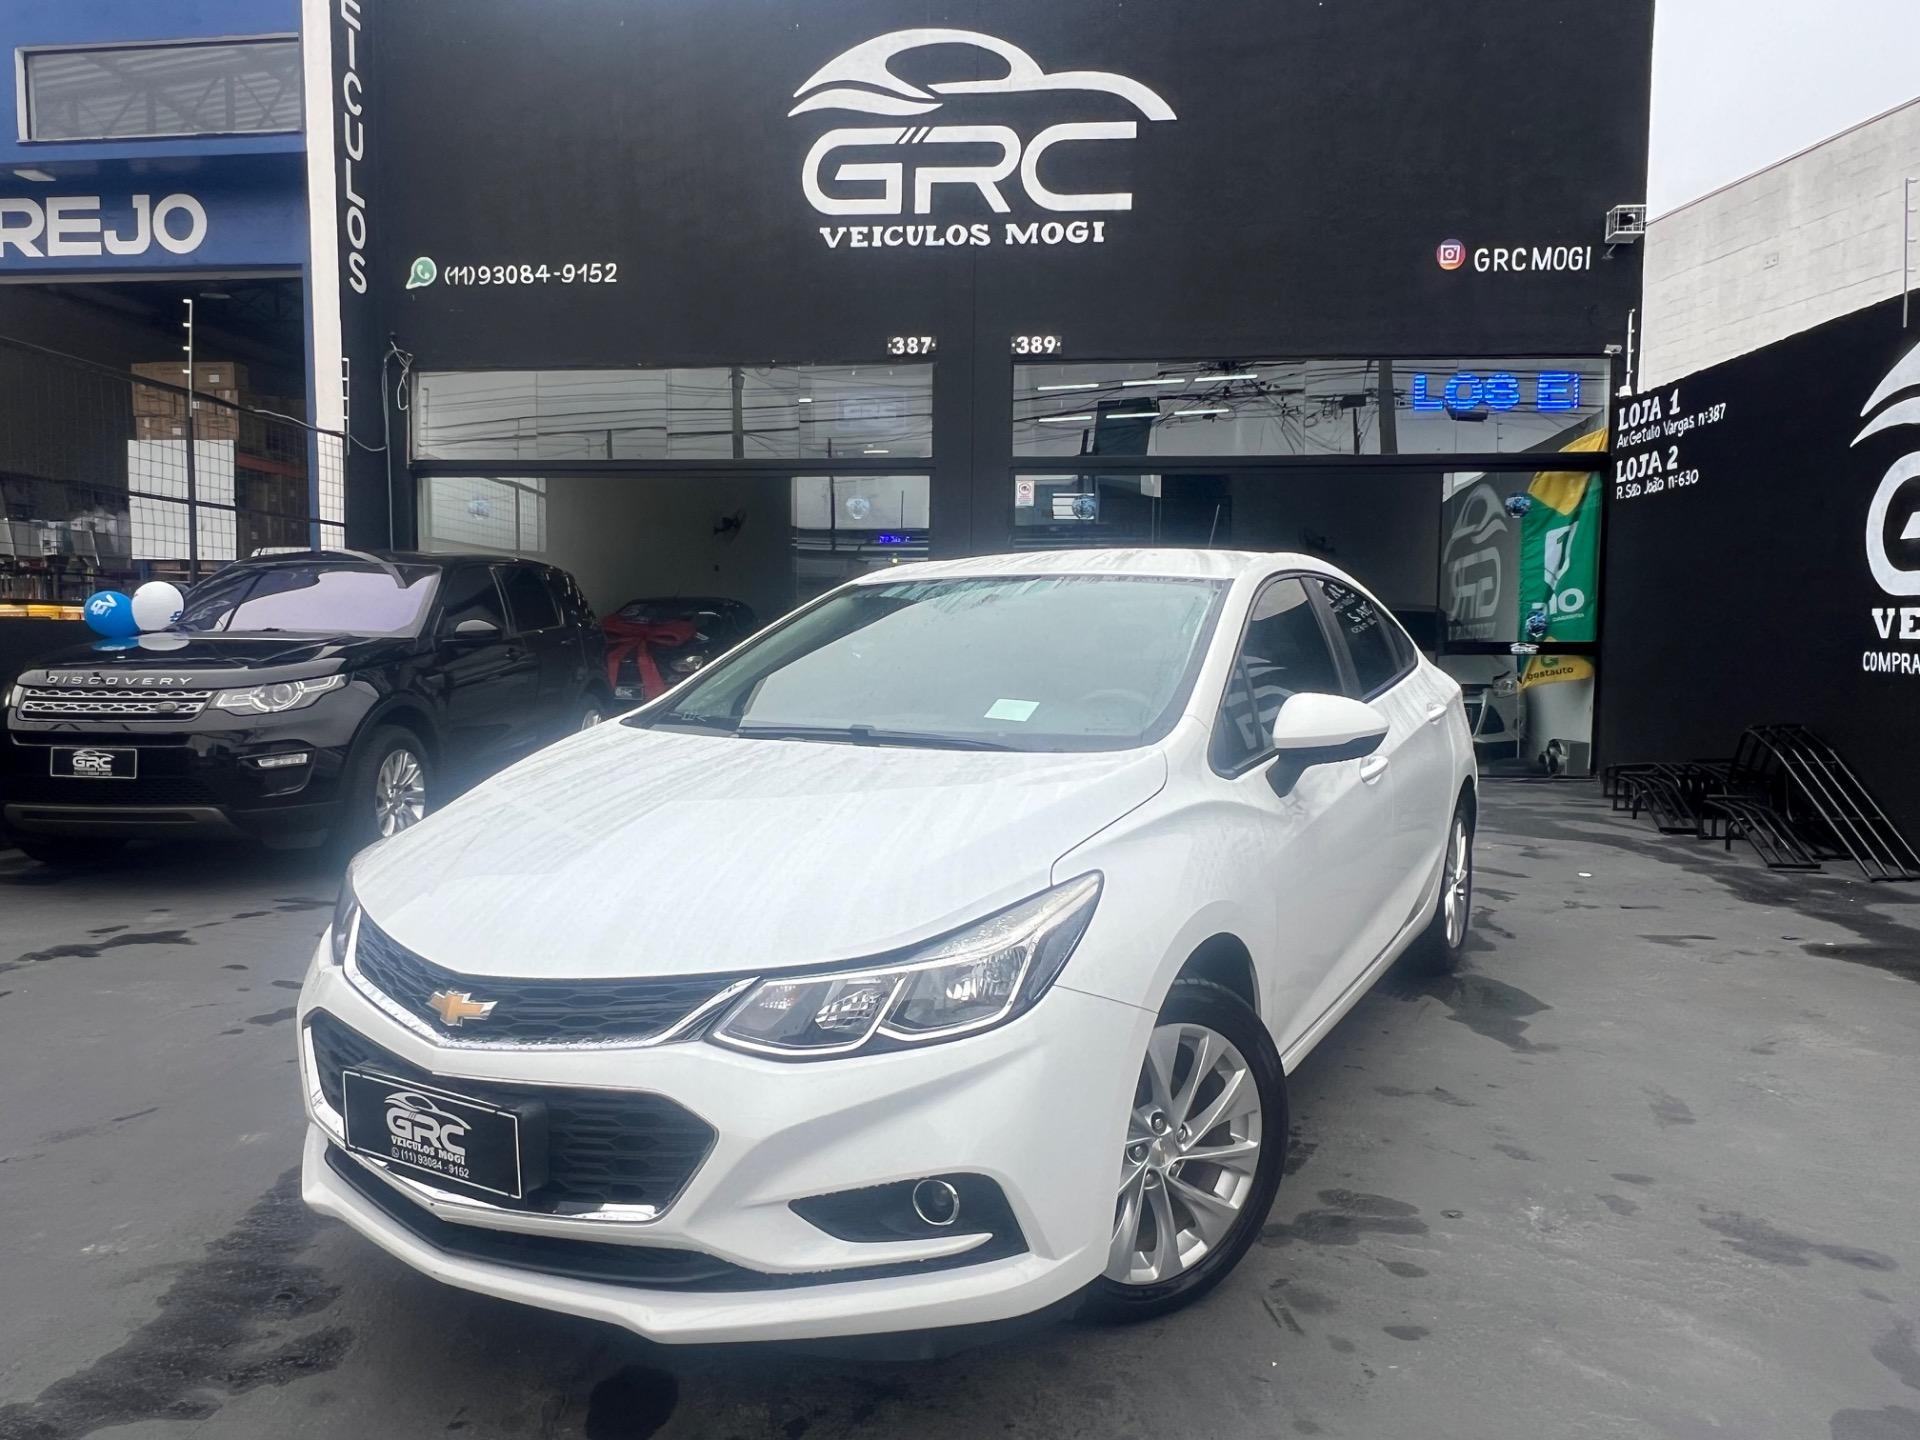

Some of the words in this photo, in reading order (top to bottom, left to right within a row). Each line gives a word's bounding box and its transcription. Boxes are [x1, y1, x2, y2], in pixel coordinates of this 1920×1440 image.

[802, 121, 1137, 215] GRC
[819, 223, 991, 248] VEICULOS
[1005, 221, 1105, 245] MOGI
[444, 263, 617, 285] (11)93084-9152
[892, 337, 932, 354] 387
[1015, 336, 1056, 354] 389
[1618, 396, 1661, 431] LOJA
[1669, 388, 1680, 415] 1
[1663, 415, 1695, 437] Vargas
[1616, 450, 1662, 483] LOJA
[1667, 445, 1678, 470] 2
[47, 675, 192, 685] DISCOVERY
[72, 756, 112, 769] GRC
[386, 1107, 465, 1156] GRC
[391, 1135, 435, 1156] VEICULOS
[438, 1149, 465, 1165] MOGI
[401, 1149, 416, 1164] (11)
